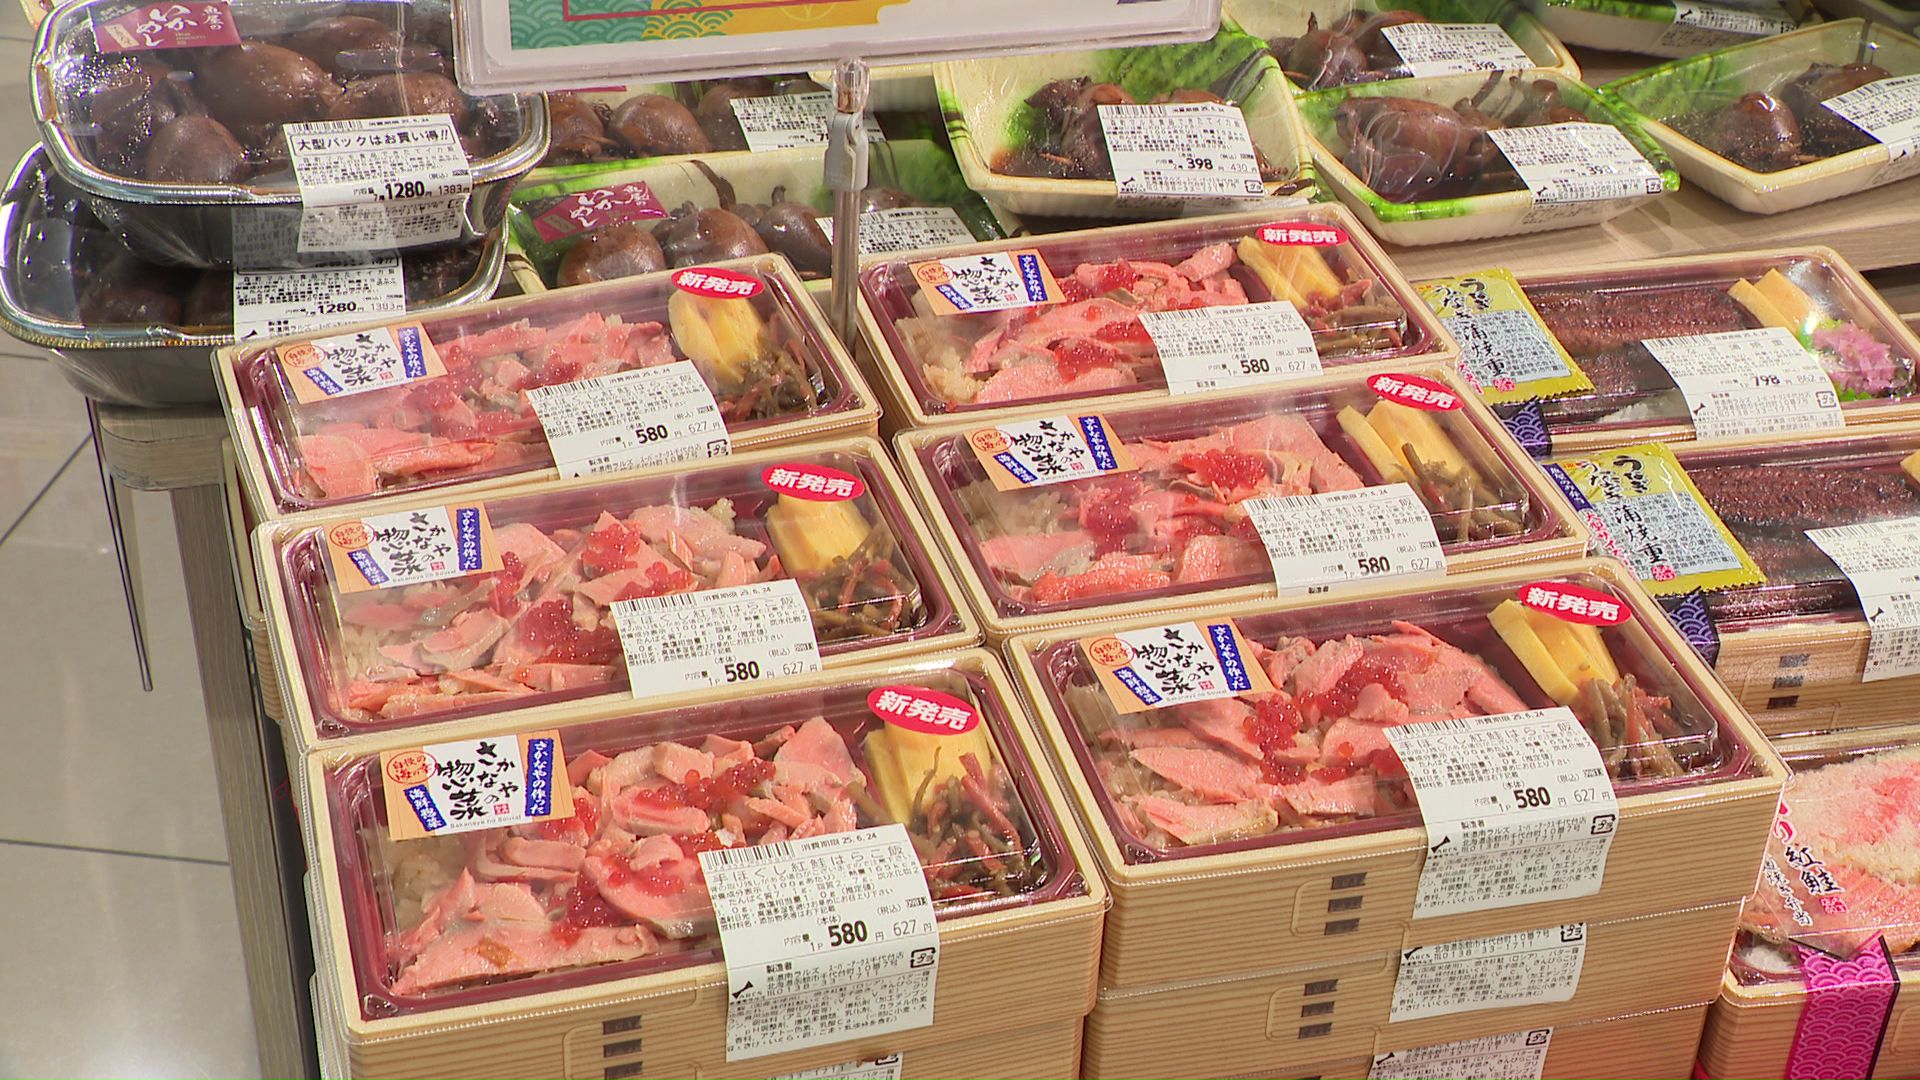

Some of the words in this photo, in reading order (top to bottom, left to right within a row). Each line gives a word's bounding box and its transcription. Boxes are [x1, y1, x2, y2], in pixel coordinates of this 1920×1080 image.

[136, 21, 165, 47] めし
[1187, 158, 1214, 170] 398
[1230, 163, 1248, 172] 430
[385, 180, 425, 200] 1280
[439, 185, 462, 195] 1383
[1263, 228, 1338, 244] 新発売
[676, 272, 756, 297] 新発売
[318, 301, 357, 314] 1280
[371, 302, 395, 311] 1383
[1240, 358, 1270, 374] 580
[1288, 360, 1306, 372] 627
[1311, 363, 1318, 371] 円
[1373, 376, 1456, 409] 新発売
[1753, 375, 1781, 387] 798
[636, 425, 668, 445] 580
[689, 421, 708, 433] 627
[712, 422, 721, 430] 円
[768, 466, 856, 496] 新発売
[461, 510, 478, 570] さかなやの作った
[1358, 556, 1391, 576] 580
[1411, 557, 1431, 571] 627
[1435, 561, 1444, 569] 円
[1527, 586, 1620, 621] 新発売
[714, 655, 737, 665] (本体)
[1214, 626, 1246, 690] さかなやの作った
[724, 660, 760, 683] 580
[782, 661, 804, 676] 627
[810, 663, 818, 672] 円
[875, 690, 971, 731] 新発売
[530, 741, 548, 815] さかなやの作った
[1502, 780, 1525, 790] (本体)
[1513, 786, 1552, 809] 580
[1574, 788, 1596, 802] 627
[1602, 791, 1611, 801] 円
[801, 838, 840, 852] 消費期限
[842, 832, 877, 844] 25.6.24
[1785, 846, 1843, 893] 紅鮭
[816, 915, 842, 926] (本体)
[1566, 925, 1582, 937] プラ
[828, 920, 868, 947] 580
[893, 919, 917, 936] 627
[923, 922, 933, 932] 円
[766, 961, 793, 974] 製造者
